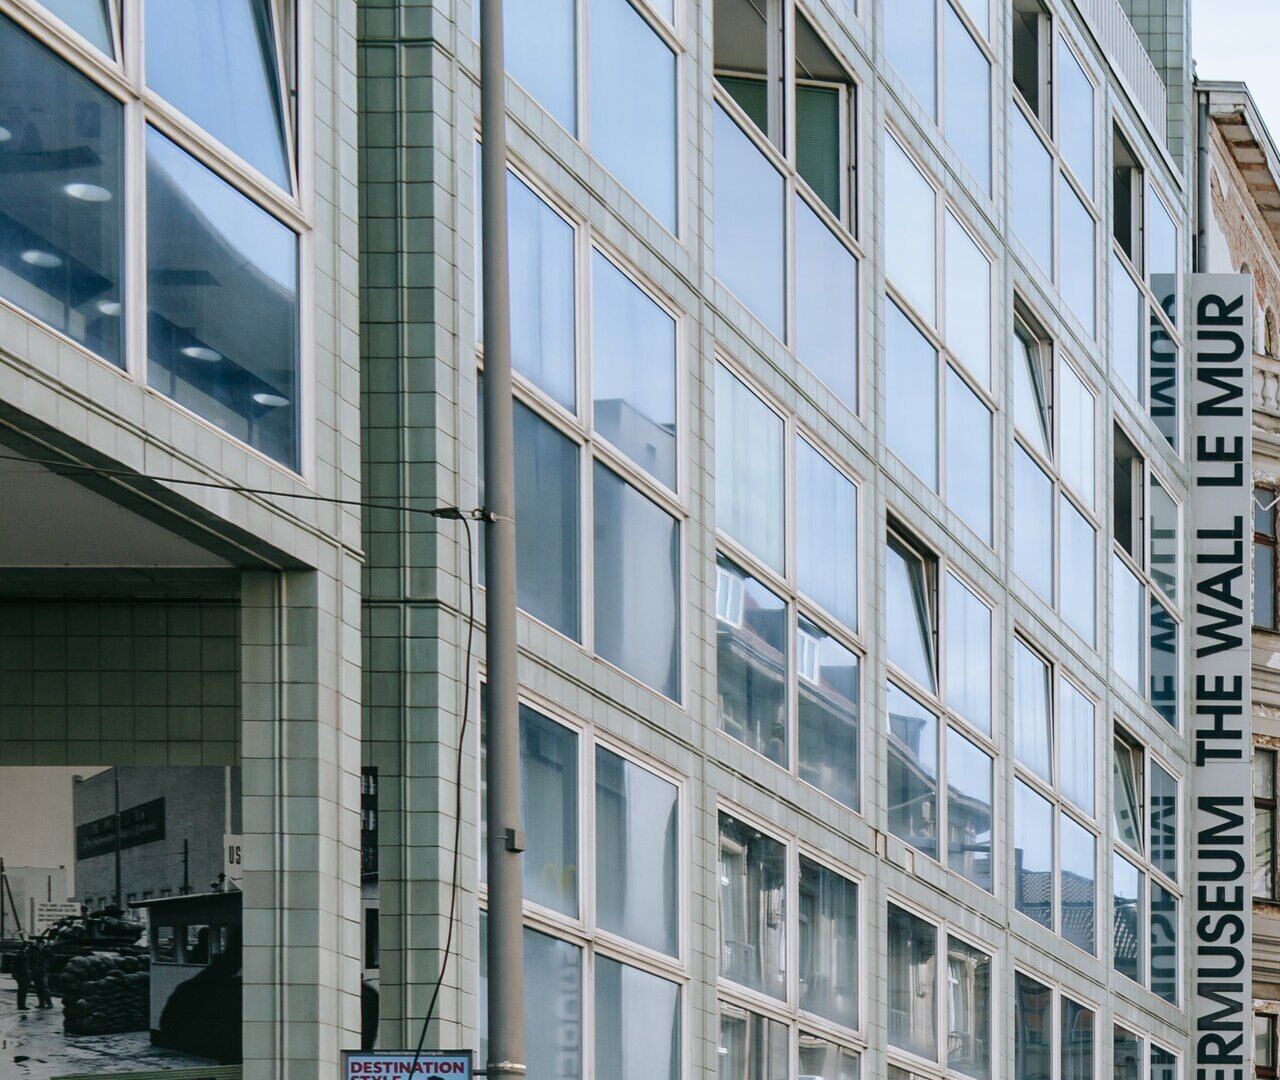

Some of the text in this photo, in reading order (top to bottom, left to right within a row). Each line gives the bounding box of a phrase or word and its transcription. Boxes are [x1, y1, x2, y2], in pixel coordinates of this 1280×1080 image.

[1196, 294, 1245, 417] MUR
[1196, 436, 1244, 487] LE
[1196, 515, 1244, 658] WALL
[1196, 674, 1243, 766] THE
[350, 1061, 465, 1074] DESTINATION
